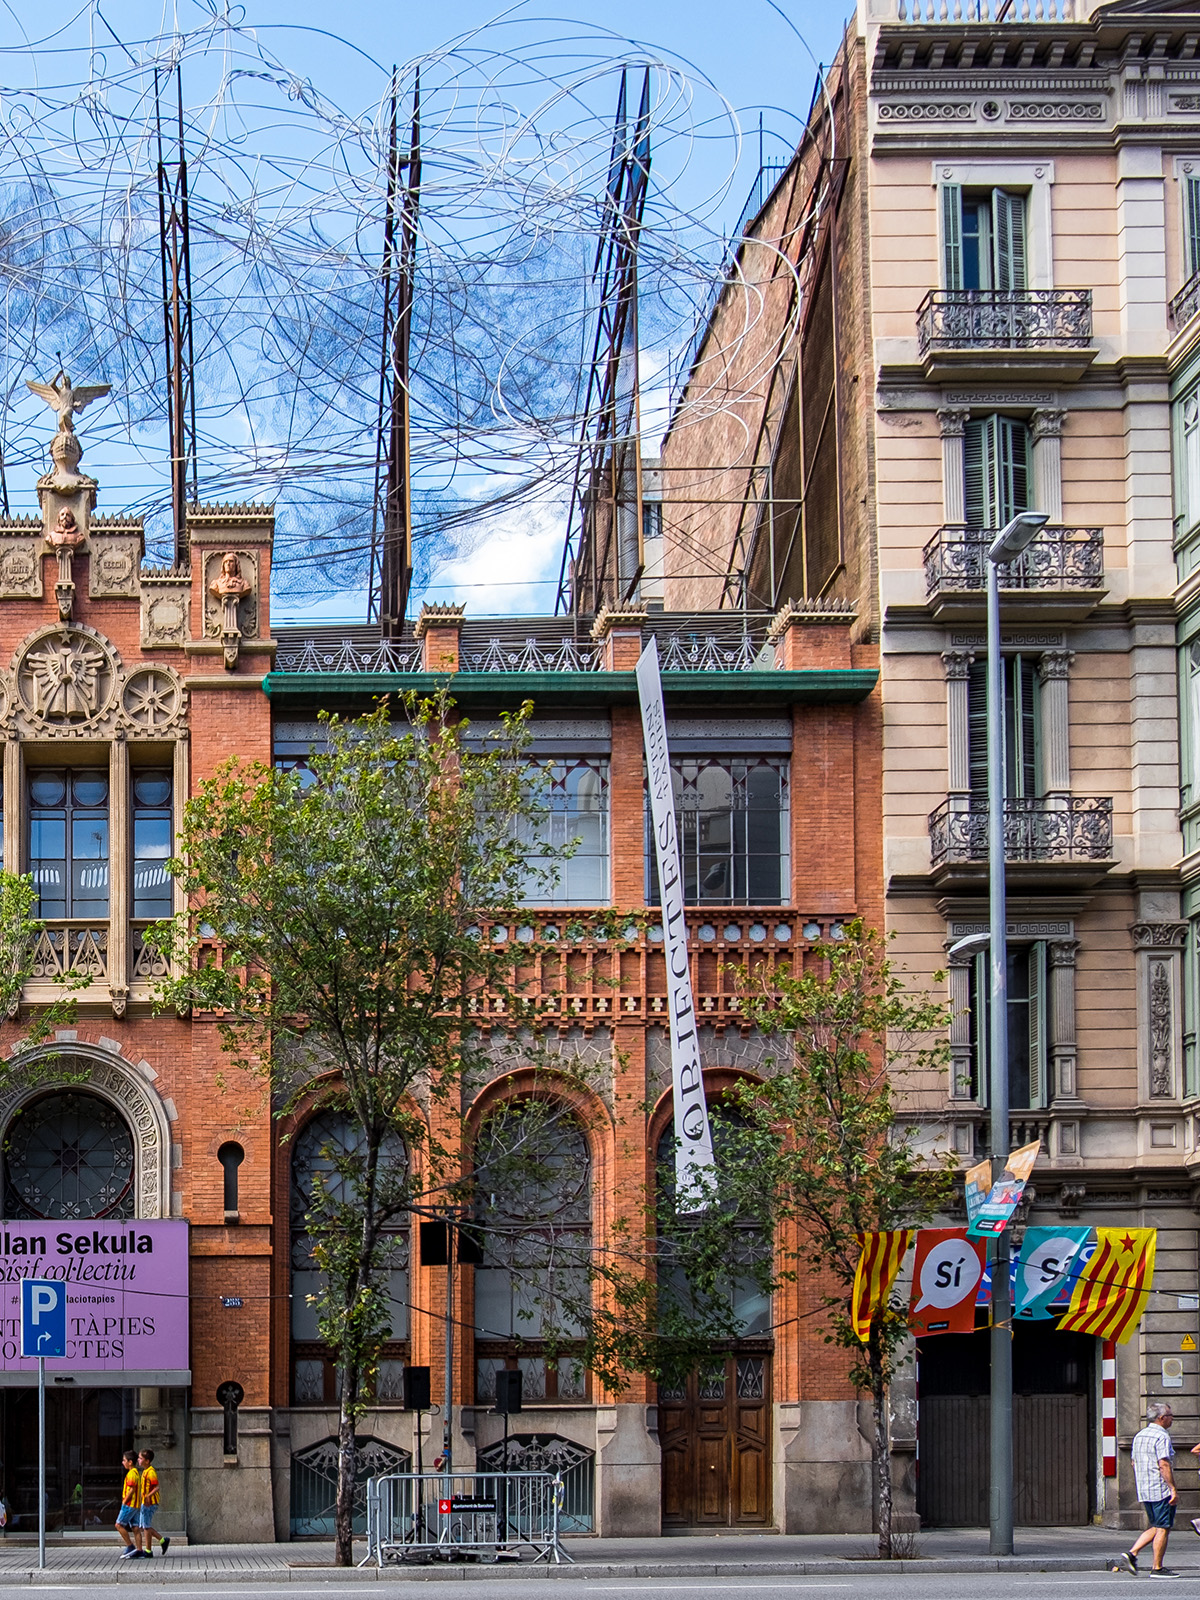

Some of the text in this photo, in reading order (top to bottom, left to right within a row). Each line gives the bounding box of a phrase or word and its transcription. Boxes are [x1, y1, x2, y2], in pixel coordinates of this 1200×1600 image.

[659, 810, 705, 1141] OBJECTES
[56, 1230, 153, 1255] Sekula
[934, 1257, 966, 1289] Sí
[31, 1285, 58, 1326] P
[71, 1313, 156, 1337] TÀPIES
